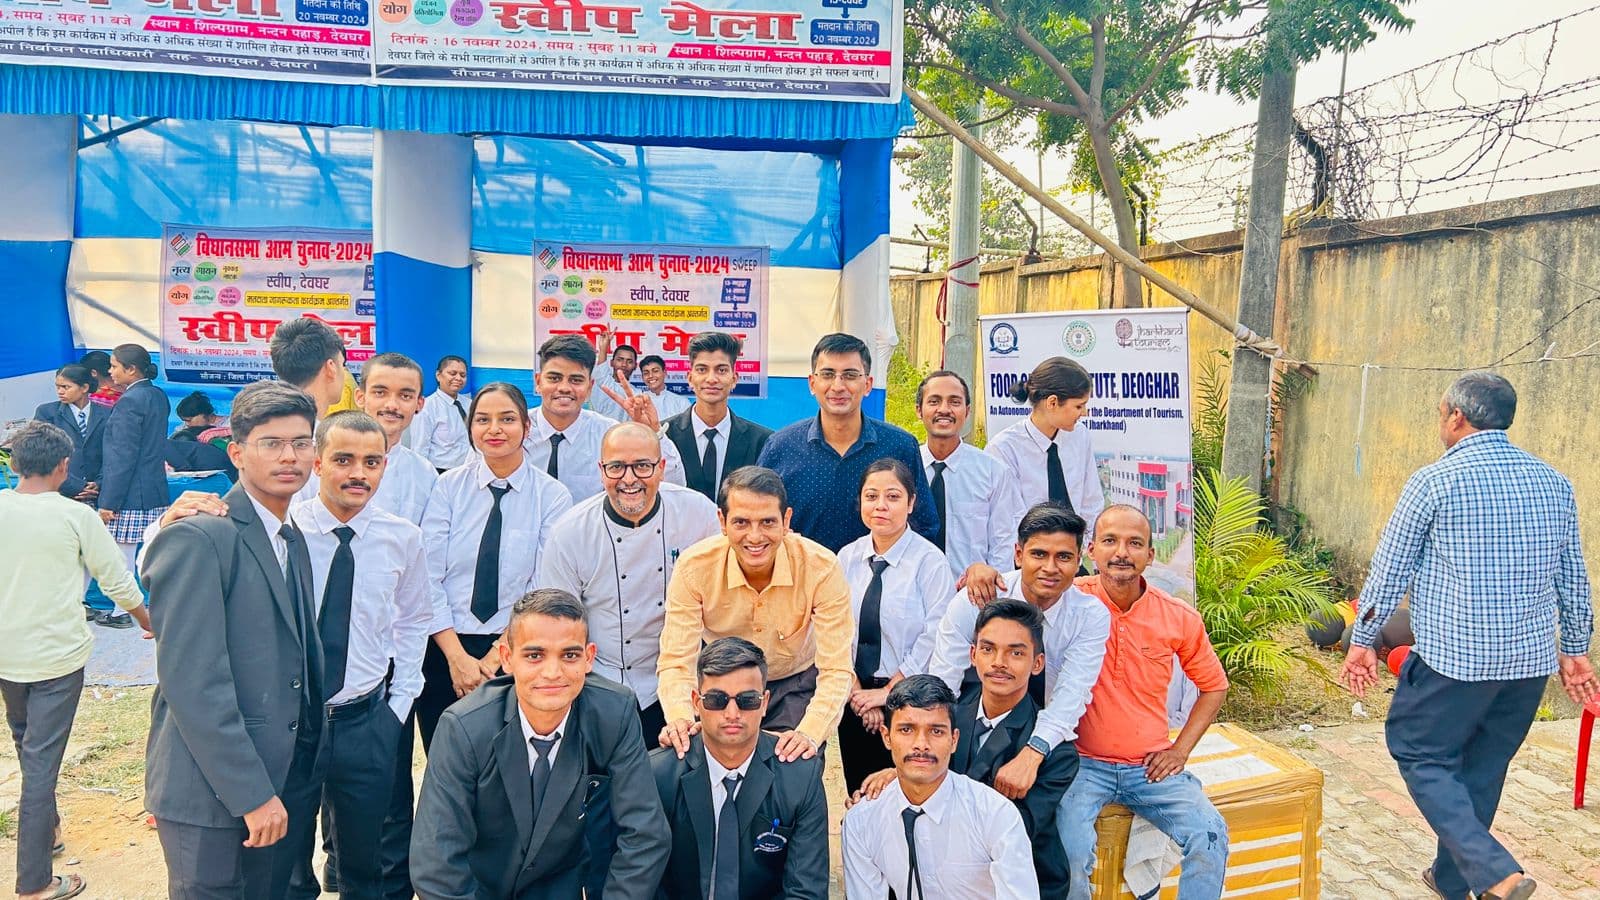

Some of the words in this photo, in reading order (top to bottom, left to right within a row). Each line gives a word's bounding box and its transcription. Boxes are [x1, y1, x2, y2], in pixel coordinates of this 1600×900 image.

[382, 3, 407, 14] योग
[12, 10, 42, 20] समय
[57, 13, 86, 26] सुबह
[91, 16, 104, 24] 11
[110, 14, 132, 26] बजे
[298, 12, 310, 20] 20
[341, 15, 366, 24] 2024
[489, 0, 641, 34] स्वीप
[661, 1, 802, 40] मेला
[818, 22, 840, 32] मतदान
[844, 20, 854, 32] की
[856, 20, 872, 32] तिथि
[150, 19, 180, 28] स्थान
[330, 28, 364, 42] देवघर
[36, 26, 49, 37] कि
[52, 29, 66, 40] इस
[69, 28, 106, 41] कार्यक्रम
[109, 31, 117, 42] में
[120, 32, 150, 44] अधिक
[153, 34, 161, 44] से
[165, 34, 194, 46] अधिक
[198, 37, 222, 48] संख्या
[226, 38, 234, 49] में
[236, 40, 266, 52] शामिल
[270, 42, 292, 54] होकर
[296, 44, 310, 56] इसे
[313, 47, 338, 57] सफल
[391, 32, 428, 46] दिनांक
[444, 37, 458, 46] 16
[462, 38, 501, 48] नवम्बर
[546, 41, 574, 51] समय
[586, 42, 614, 54] सुबह
[620, 44, 632, 52] 11
[636, 42, 657, 54] बजे
[812, 34, 824, 43] 20
[854, 36, 876, 45] 2024
[674, 46, 702, 56] स्थान
[842, 50, 875, 62] देवघर
[388, 49, 412, 60] देवघर
[416, 50, 434, 60] जिले
[438, 51, 447, 62] के
[450, 51, 470, 62] सभी
[473, 53, 516, 65] मतदाताओं
[520, 54, 527, 65] से
[530, 54, 556, 66] अपील
[560, 56, 566, 68] है
[568, 56, 580, 67] कि
[584, 59, 596, 68] इस
[600, 57, 633, 69] कार्यक्रम
[646, 60, 674, 70] अधिक
[676, 61, 684, 72] से
[688, 61, 716, 72] अधिक
[718, 62, 742, 73] संख्या
[754, 64, 782, 75] शामिल
[786, 66, 807, 76] होकर
[810, 67, 822, 77] इसे
[826, 68, 848, 78] सफल
[450, 67, 497, 78] सौजन्य
[512, 70, 547, 80] जिला
[552, 71, 602, 82] निर्वाचन
[196, 233, 261, 258] विधानसभा
[266, 240, 293, 259] आम
[562, 246, 623, 271] विधानसभा
[628, 254, 654, 272] आम
[172, 266, 190, 276] नृत्य
[196, 266, 216, 275] गायन
[300, 272, 330, 289] देवघर
[541, 280, 558, 290] नृत्य
[563, 280, 582, 288] गायन
[170, 290, 189, 300] योग
[662, 286, 690, 302] देवघर
[542, 304, 558, 313] योग
[1122, 372, 1180, 399] DEOGHAR
[990, 406, 998, 415] An
[1092, 406, 1102, 417] the
[1104, 407, 1144, 419] Department
[1145, 408, 1152, 418] of
